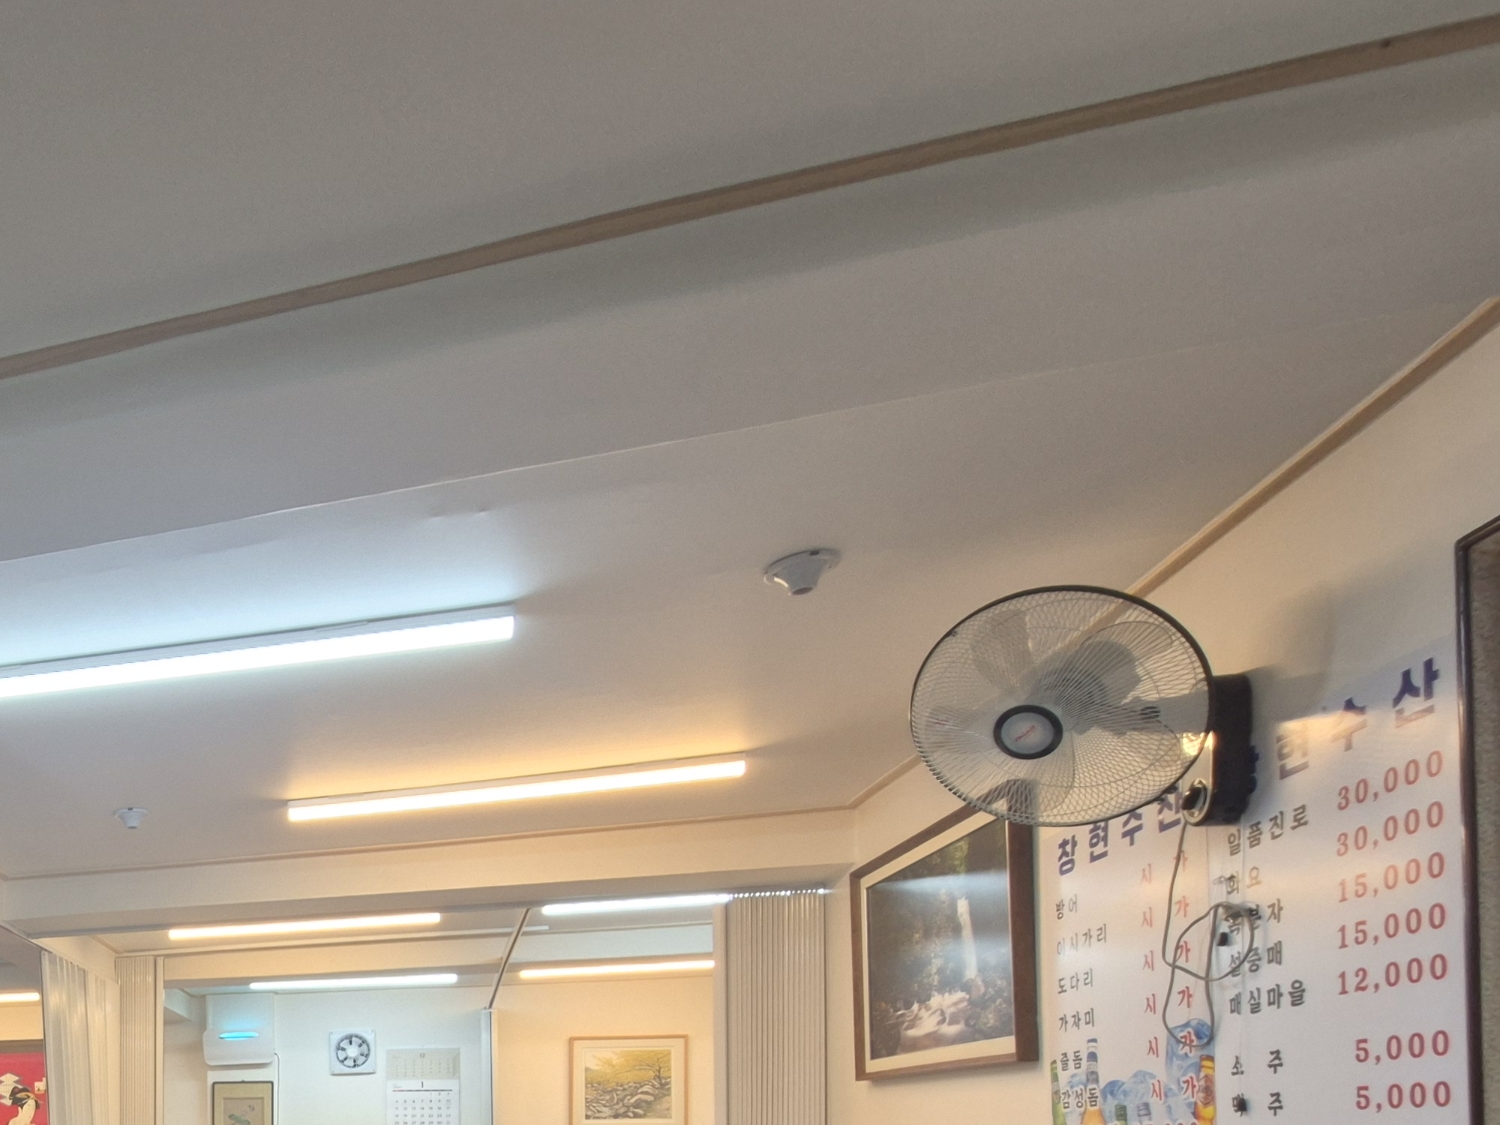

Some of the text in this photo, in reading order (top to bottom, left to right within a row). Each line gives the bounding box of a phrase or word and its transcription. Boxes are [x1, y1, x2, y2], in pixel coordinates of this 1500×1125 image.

[1227, 750, 1443, 856] 일품진로 30,000
[1336, 801, 1444, 857] 30,000
[1338, 851, 1445, 903] 15,000
[1055, 894, 1078, 920] 방어
[1056, 923, 1107, 956] 이시가리
[1338, 902, 1446, 949] 15,000
[1057, 968, 1093, 994] 도다리
[1229, 953, 1448, 1015] 매실마을 12,000
[1058, 1007, 1095, 1032] 가자미
[1355, 1029, 1450, 1065] 5,000
[1061, 1087, 1099, 1109] 감성돔
[1356, 1081, 1451, 1114] 5,000
